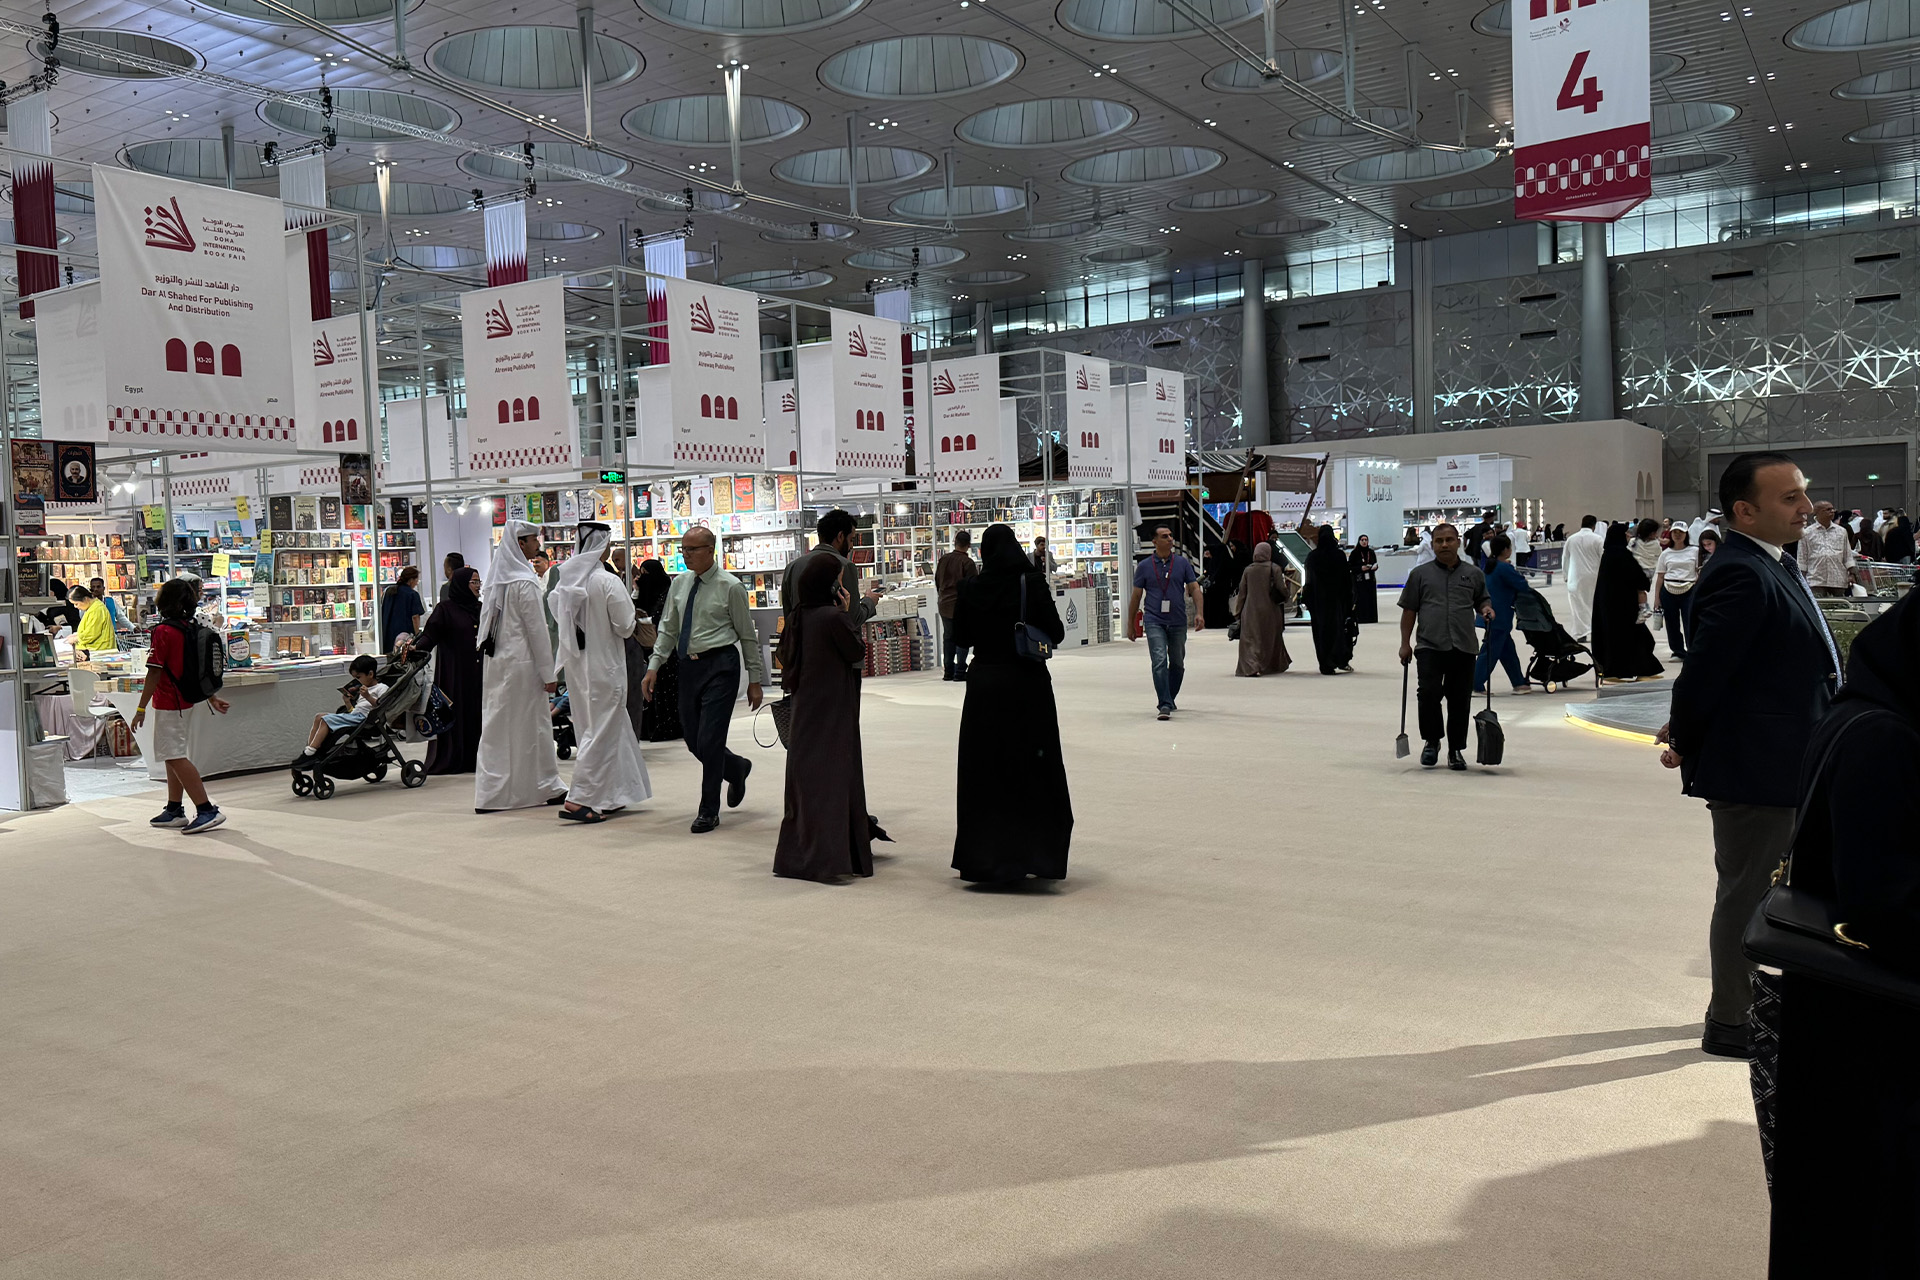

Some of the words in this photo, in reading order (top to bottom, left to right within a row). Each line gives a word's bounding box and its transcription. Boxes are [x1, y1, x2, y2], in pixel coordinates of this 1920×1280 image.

[1556, 50, 1603, 114] 4
[202, 241, 245, 253] INTERNATIONAL
[204, 250, 225, 258] BOOK
[155, 274, 182, 286] والتوزيع
[184, 277, 203, 287] للنشر
[204, 281, 229, 290] الشاهد
[230, 283, 240, 292] دار
[141, 287, 156, 296] Dar
[158, 290, 166, 298] Al
[168, 291, 198, 302] Shahed
[199, 295, 212, 304] For
[214, 297, 253, 310] Publishing
[168, 303, 183, 311] And
[186, 304, 230, 317] Distribution
[125, 385, 144, 394] Egypt
